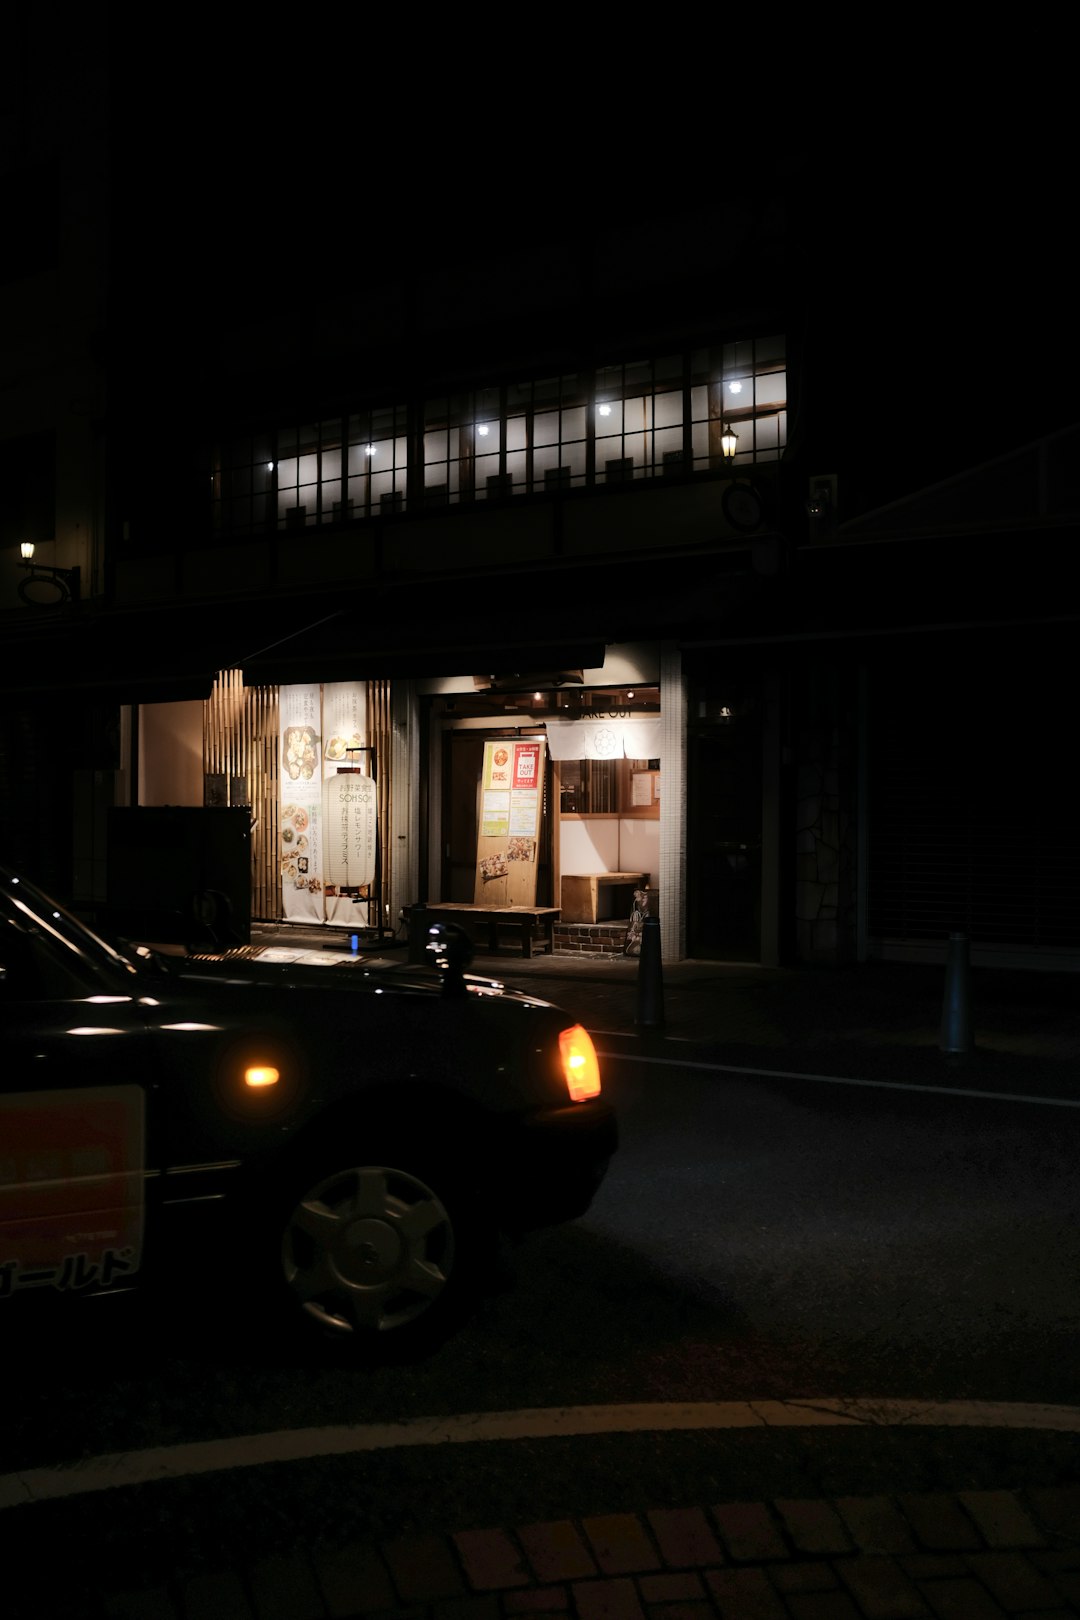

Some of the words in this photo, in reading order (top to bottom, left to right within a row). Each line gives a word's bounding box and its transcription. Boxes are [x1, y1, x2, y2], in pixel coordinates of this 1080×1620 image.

[354, 807, 362, 857] 塩レモンサワー
